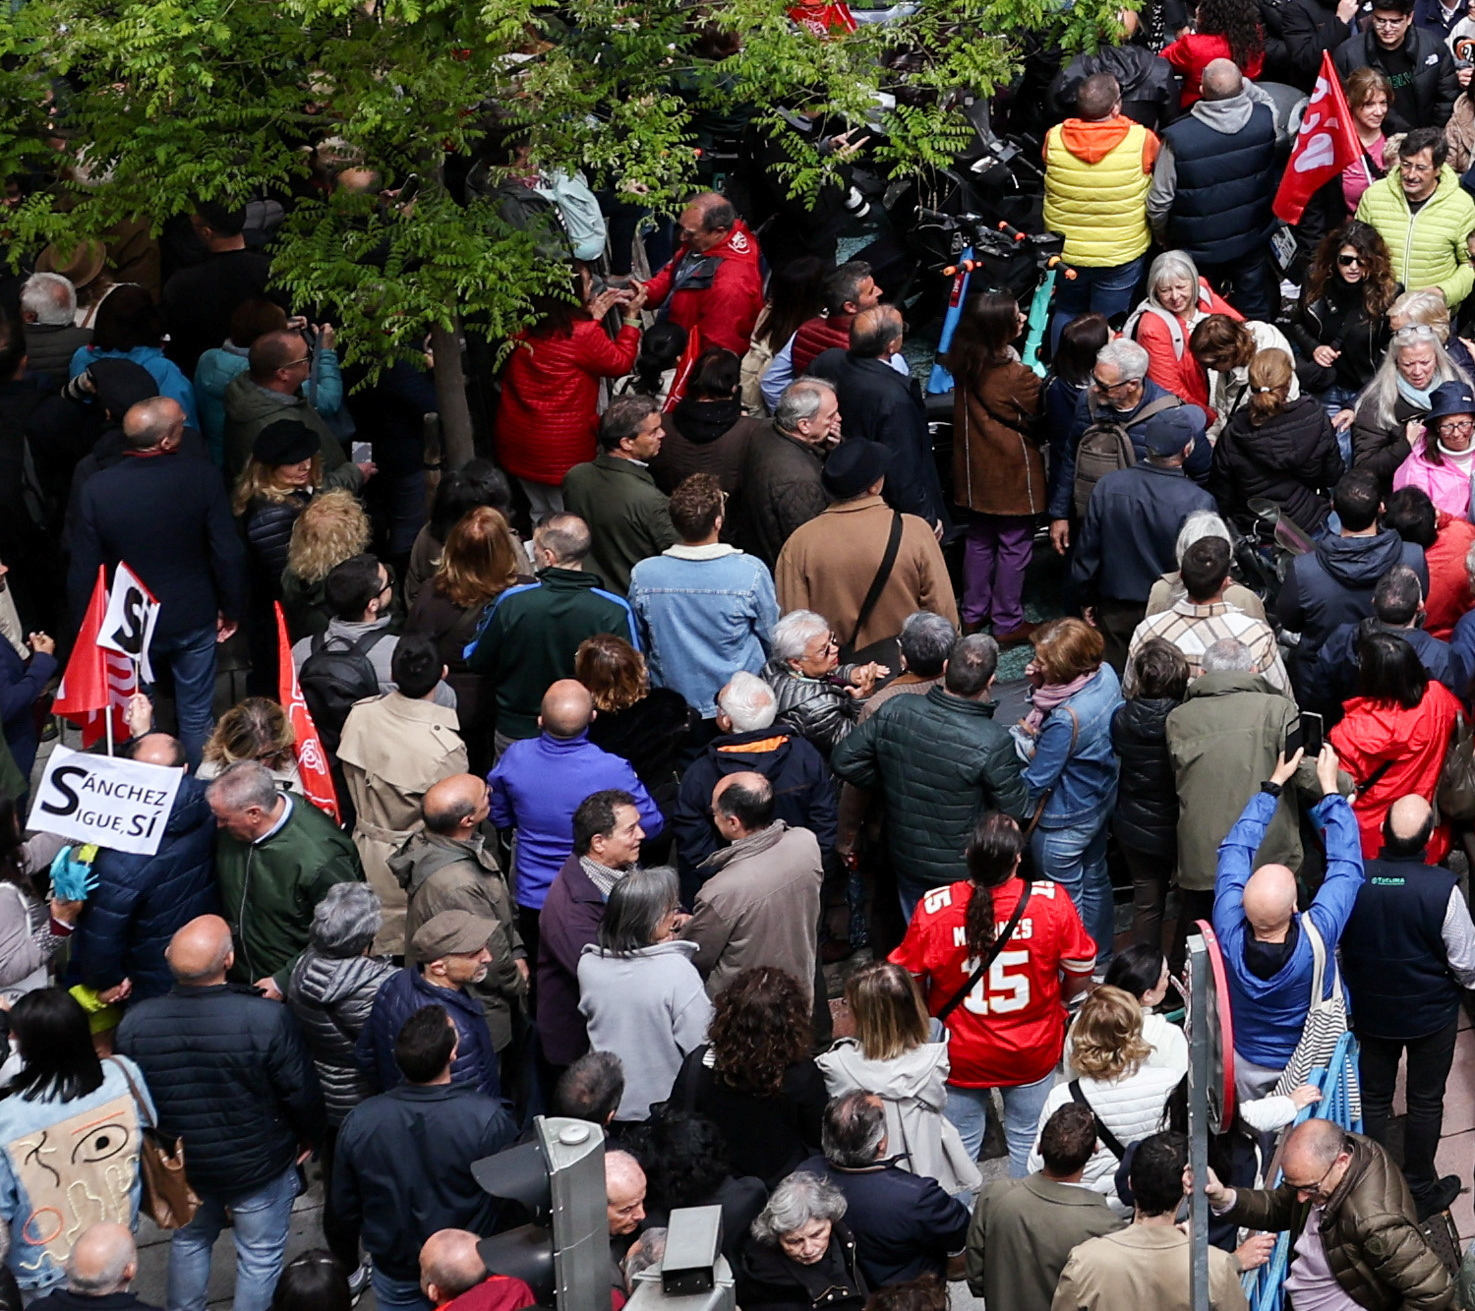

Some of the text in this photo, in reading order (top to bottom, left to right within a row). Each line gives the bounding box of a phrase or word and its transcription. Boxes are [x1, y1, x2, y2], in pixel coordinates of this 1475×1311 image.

[126, 809, 162, 839] SÍ
[924, 885, 952, 915] 15
[962, 950, 1031, 1015] 15
